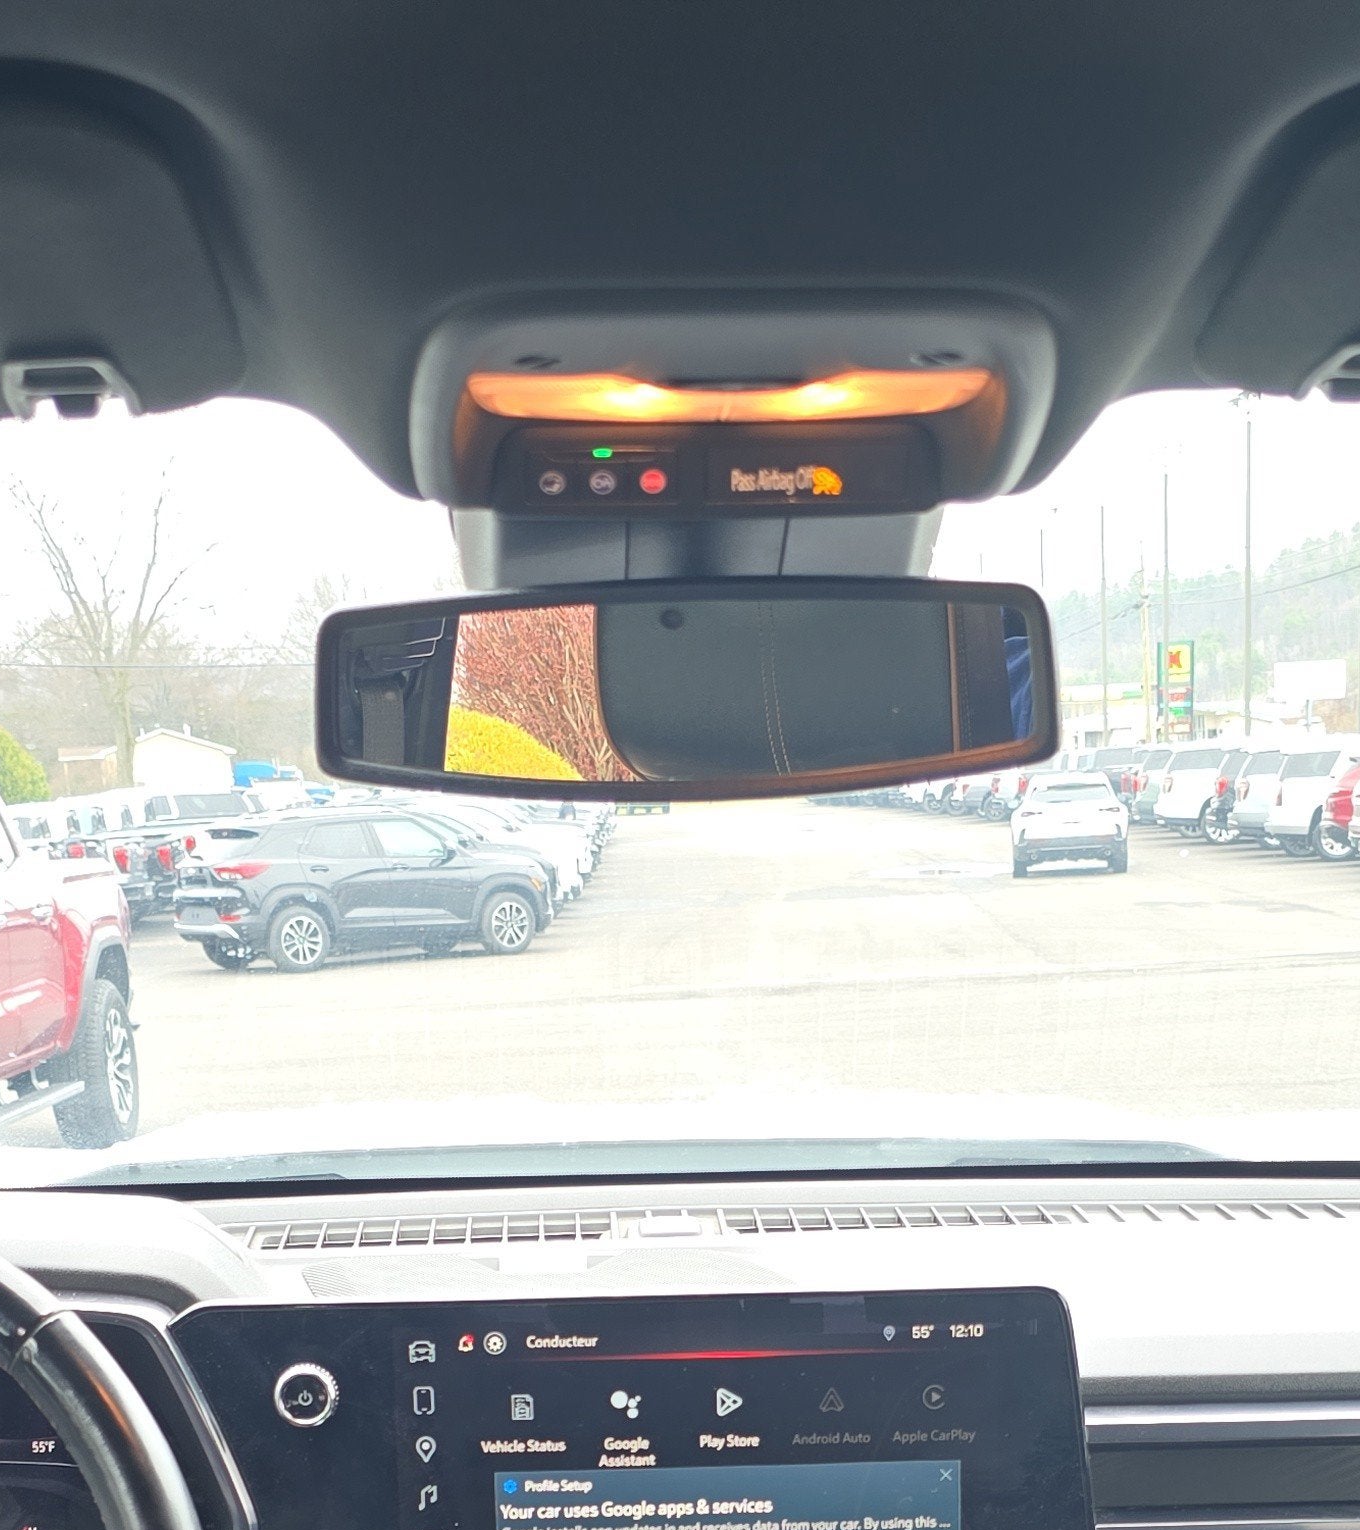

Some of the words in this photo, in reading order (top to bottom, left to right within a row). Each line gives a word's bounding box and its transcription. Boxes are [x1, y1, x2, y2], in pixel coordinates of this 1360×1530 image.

[731, 468, 756, 492] Pass
[757, 466, 795, 495] Airbag
[948, 1323, 984, 1338] 12:10
[526, 1334, 599, 1350] Conducteur
[699, 1434, 726, 1451] Play
[726, 1433, 760, 1448] Store
[792, 1432, 840, 1446] Android
[842, 1431, 871, 1444] Auto
[892, 1430, 928, 1445] Apple
[930, 1428, 977, 1443] CarPlay
[480, 1439, 525, 1453] Vehicle
[526, 1438, 567, 1452] Status
[603, 1436, 651, 1453] Google
[598, 1453, 657, 1468] Assistant
[523, 1480, 560, 1493] Profile
[560, 1479, 593, 1494] Setup
[499, 1504, 535, 1520] Your
[536, 1506, 562, 1519] car
[563, 1505, 599, 1519] uses
[601, 1500, 656, 1520] Google
[657, 1502, 695, 1519] apps
[696, 1499, 710, 1515] &
[712, 1498, 774, 1515] services
[839, 1519, 862, 1530] car.
[915, 1515, 938, 1529] this
